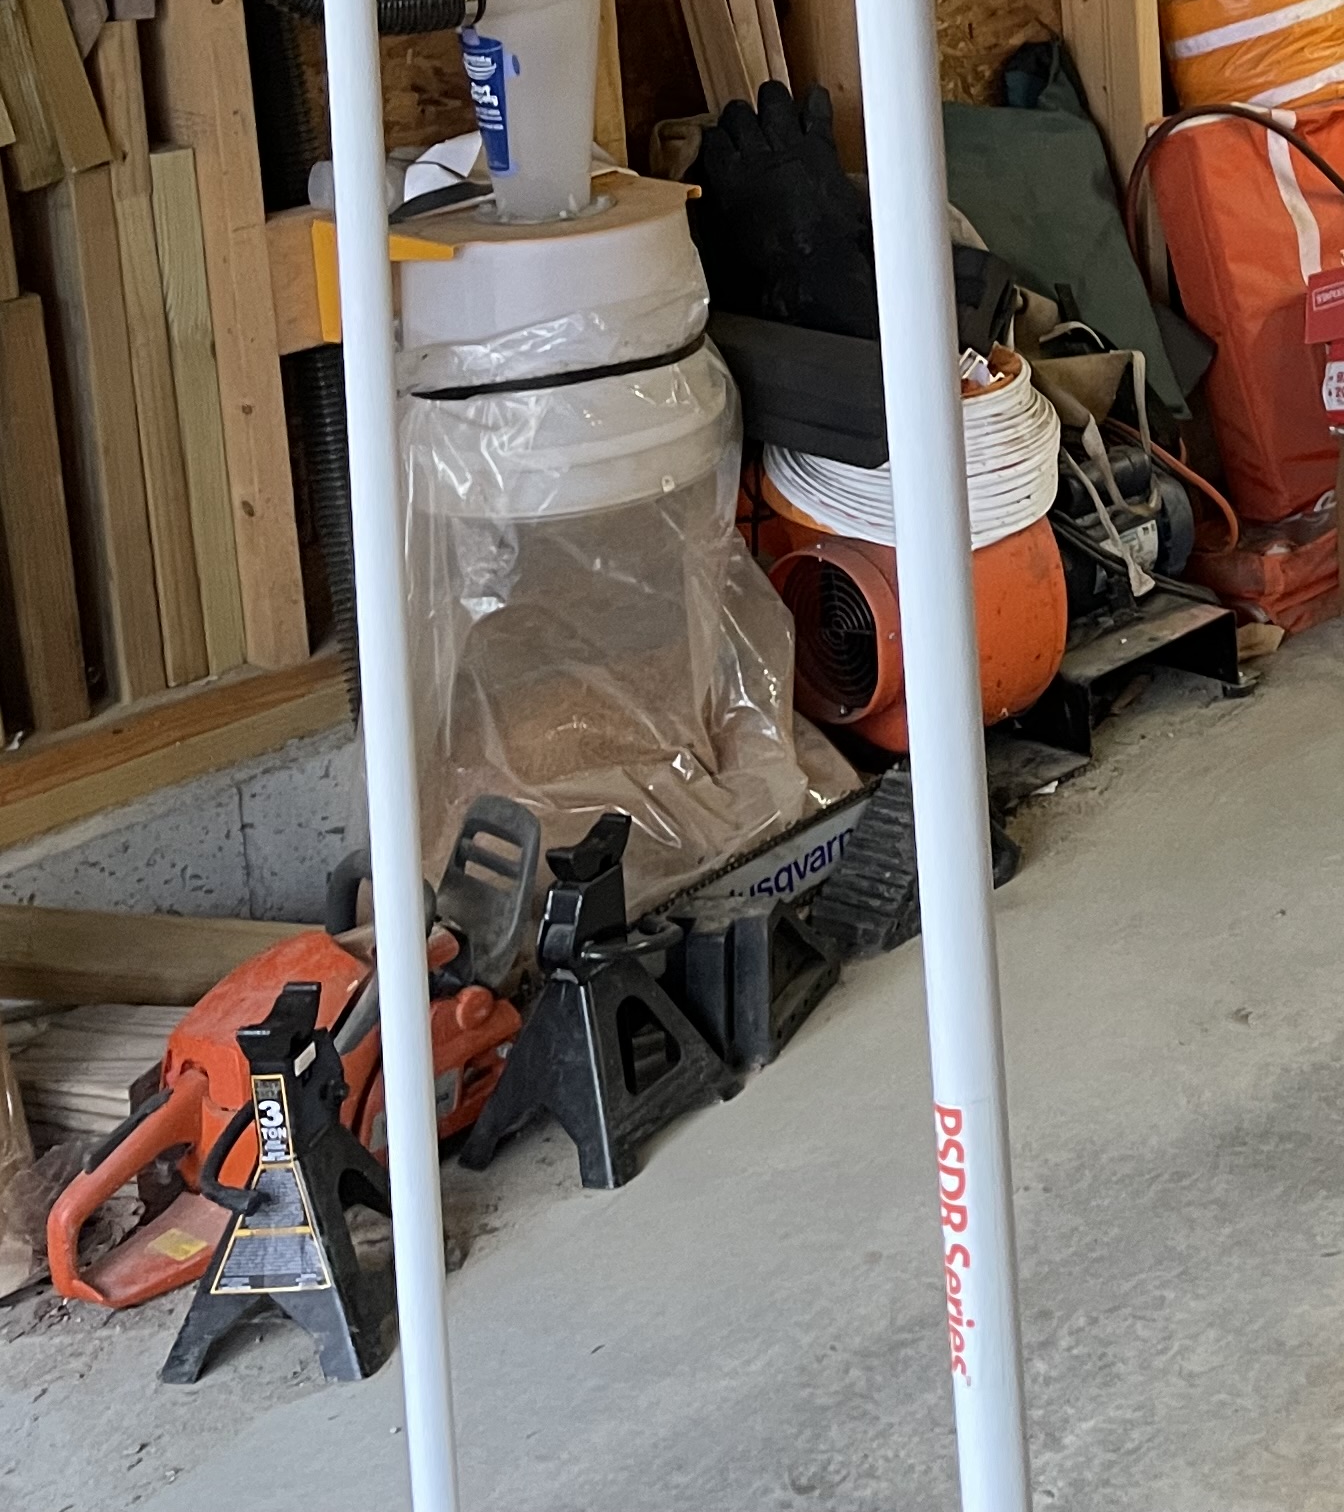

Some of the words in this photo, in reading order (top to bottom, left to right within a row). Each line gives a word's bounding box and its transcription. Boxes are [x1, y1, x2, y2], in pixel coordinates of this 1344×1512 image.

[258, 1099, 284, 1128] 3
[260, 1127, 287, 1141] TON
[934, 1103, 969, 1233] PSDR
[946, 1243, 976, 1377] Series
